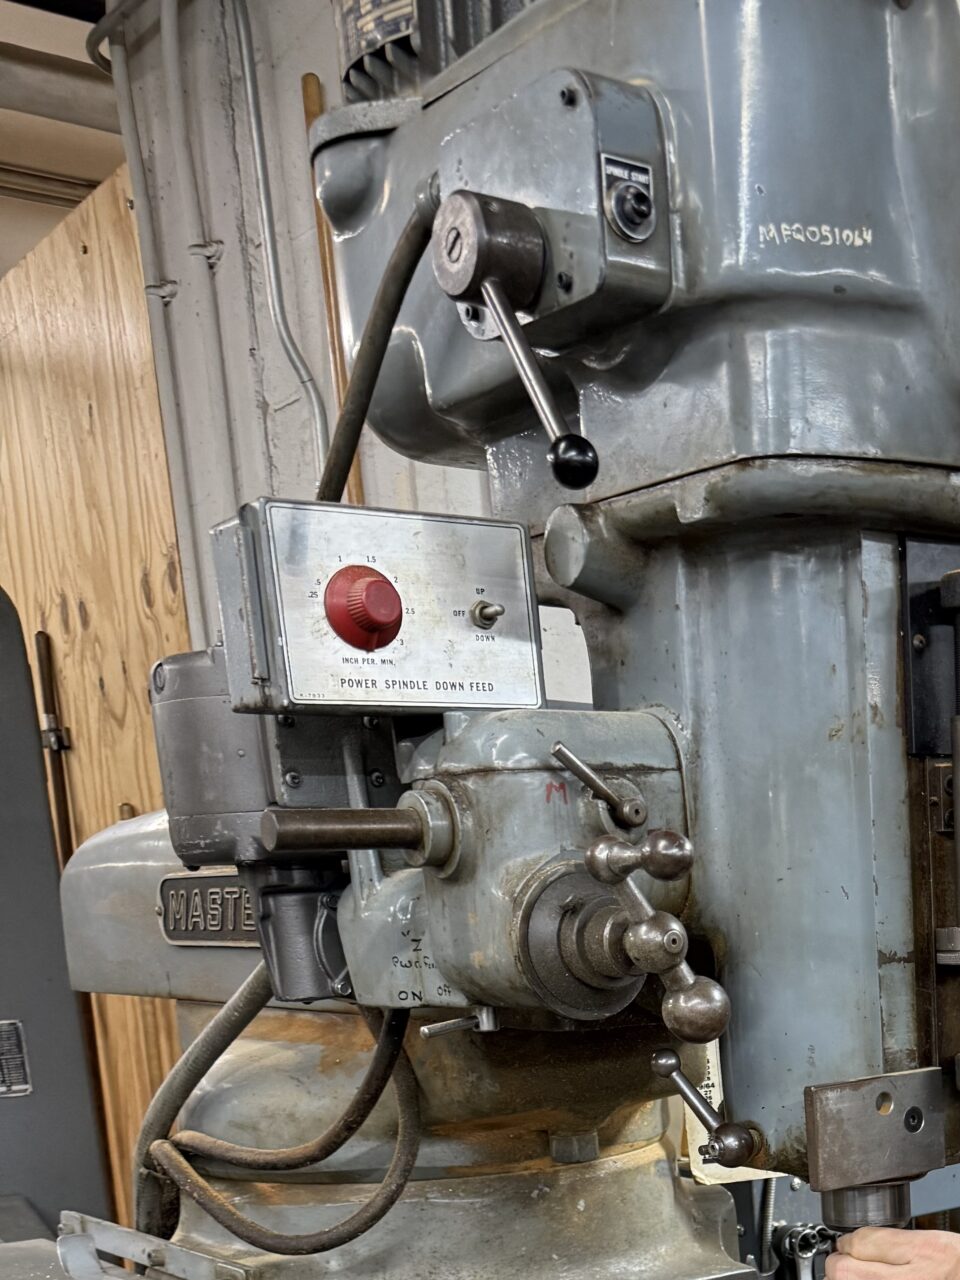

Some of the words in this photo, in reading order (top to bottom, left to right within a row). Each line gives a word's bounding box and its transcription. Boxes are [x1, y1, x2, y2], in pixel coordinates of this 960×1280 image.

[366, 555, 377, 563] 1.5
[405, 607, 416, 615] 2.5
[475, 634, 496, 642] DOWN
[342, 657, 359, 665] INCH
[340, 678, 378, 689] POWER
[385, 679, 429, 690] SPINDLE
[435, 681, 465, 691] DOWN
[470, 682, 494, 692] FEED
[398, 990, 423, 1003] ON
